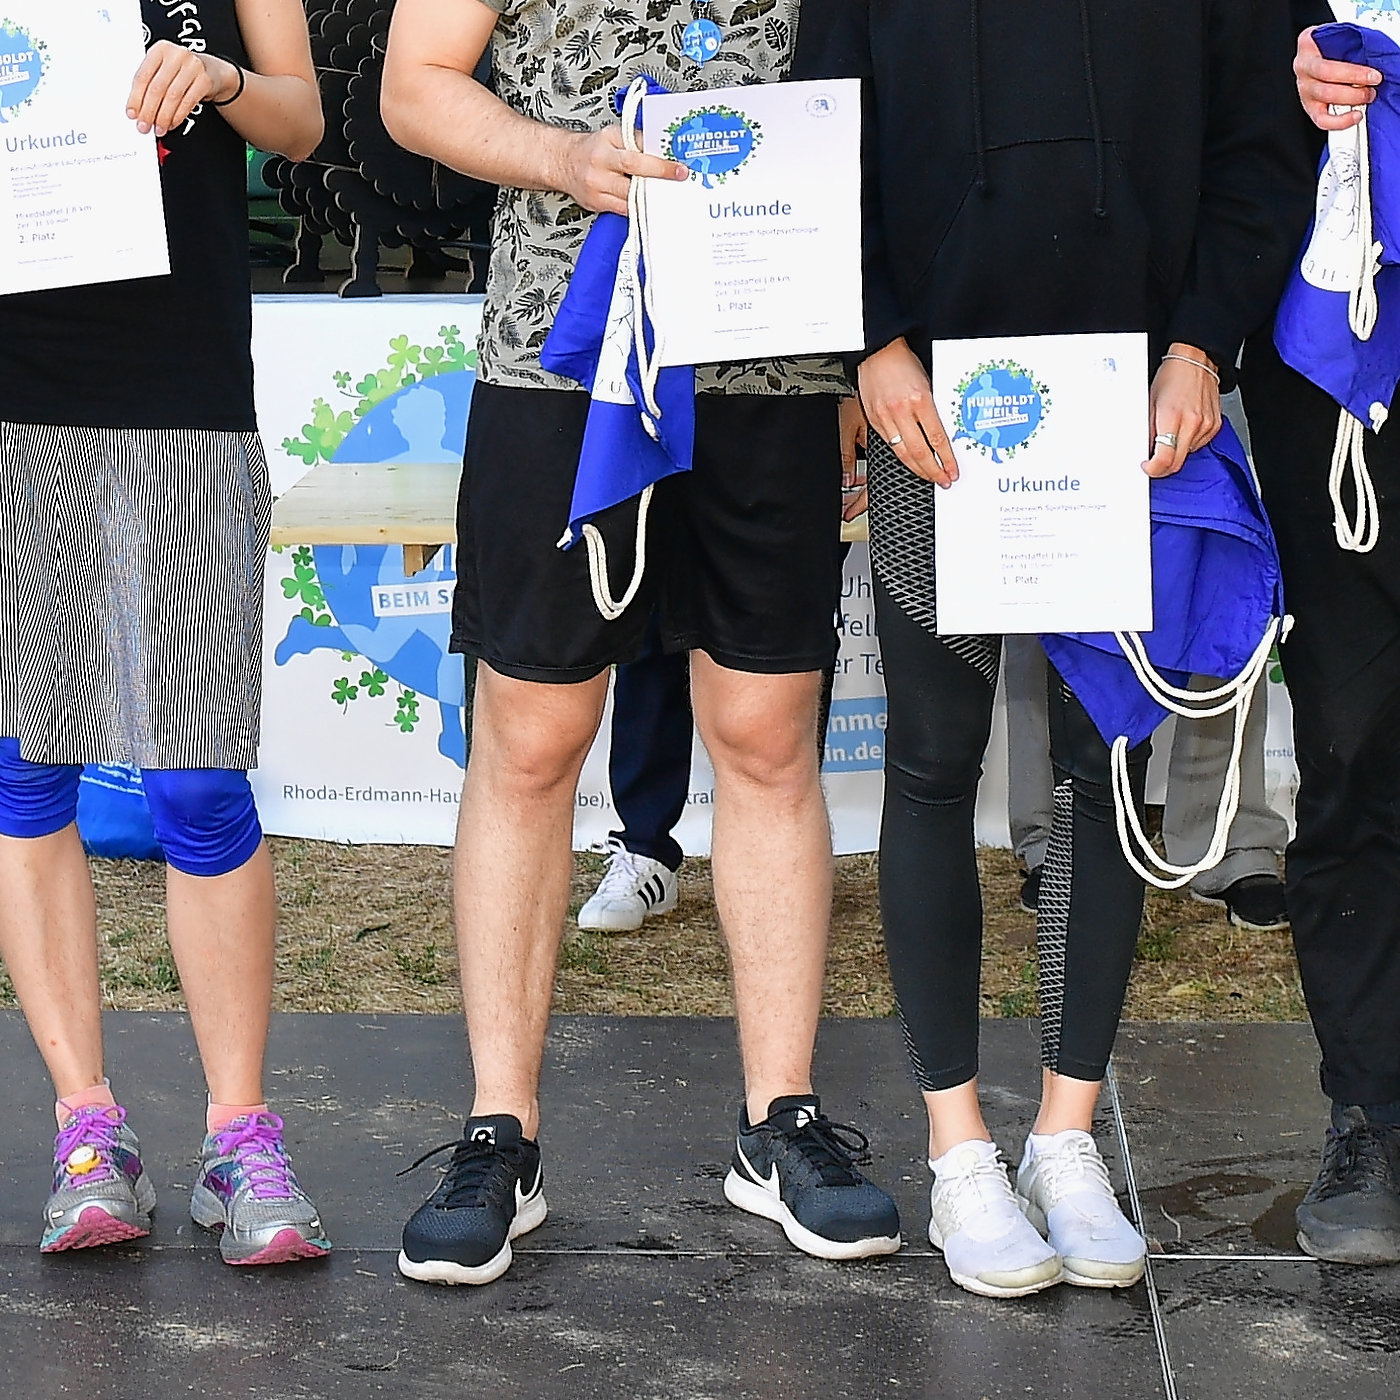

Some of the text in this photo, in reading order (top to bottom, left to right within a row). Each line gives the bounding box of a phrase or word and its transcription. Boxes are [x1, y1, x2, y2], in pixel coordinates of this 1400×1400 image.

[5, 129, 88, 153] Urkunde
[677, 129, 747, 144] HUMBOLDT
[709, 200, 792, 219] Urkunde
[32, 232, 55, 242] Platz
[729, 302, 752, 310] Platz
[966, 394, 1035, 407] HUMBOLDT
[997, 475, 1080, 493] Urkunde
[378, 588, 453, 609] BEIM S
